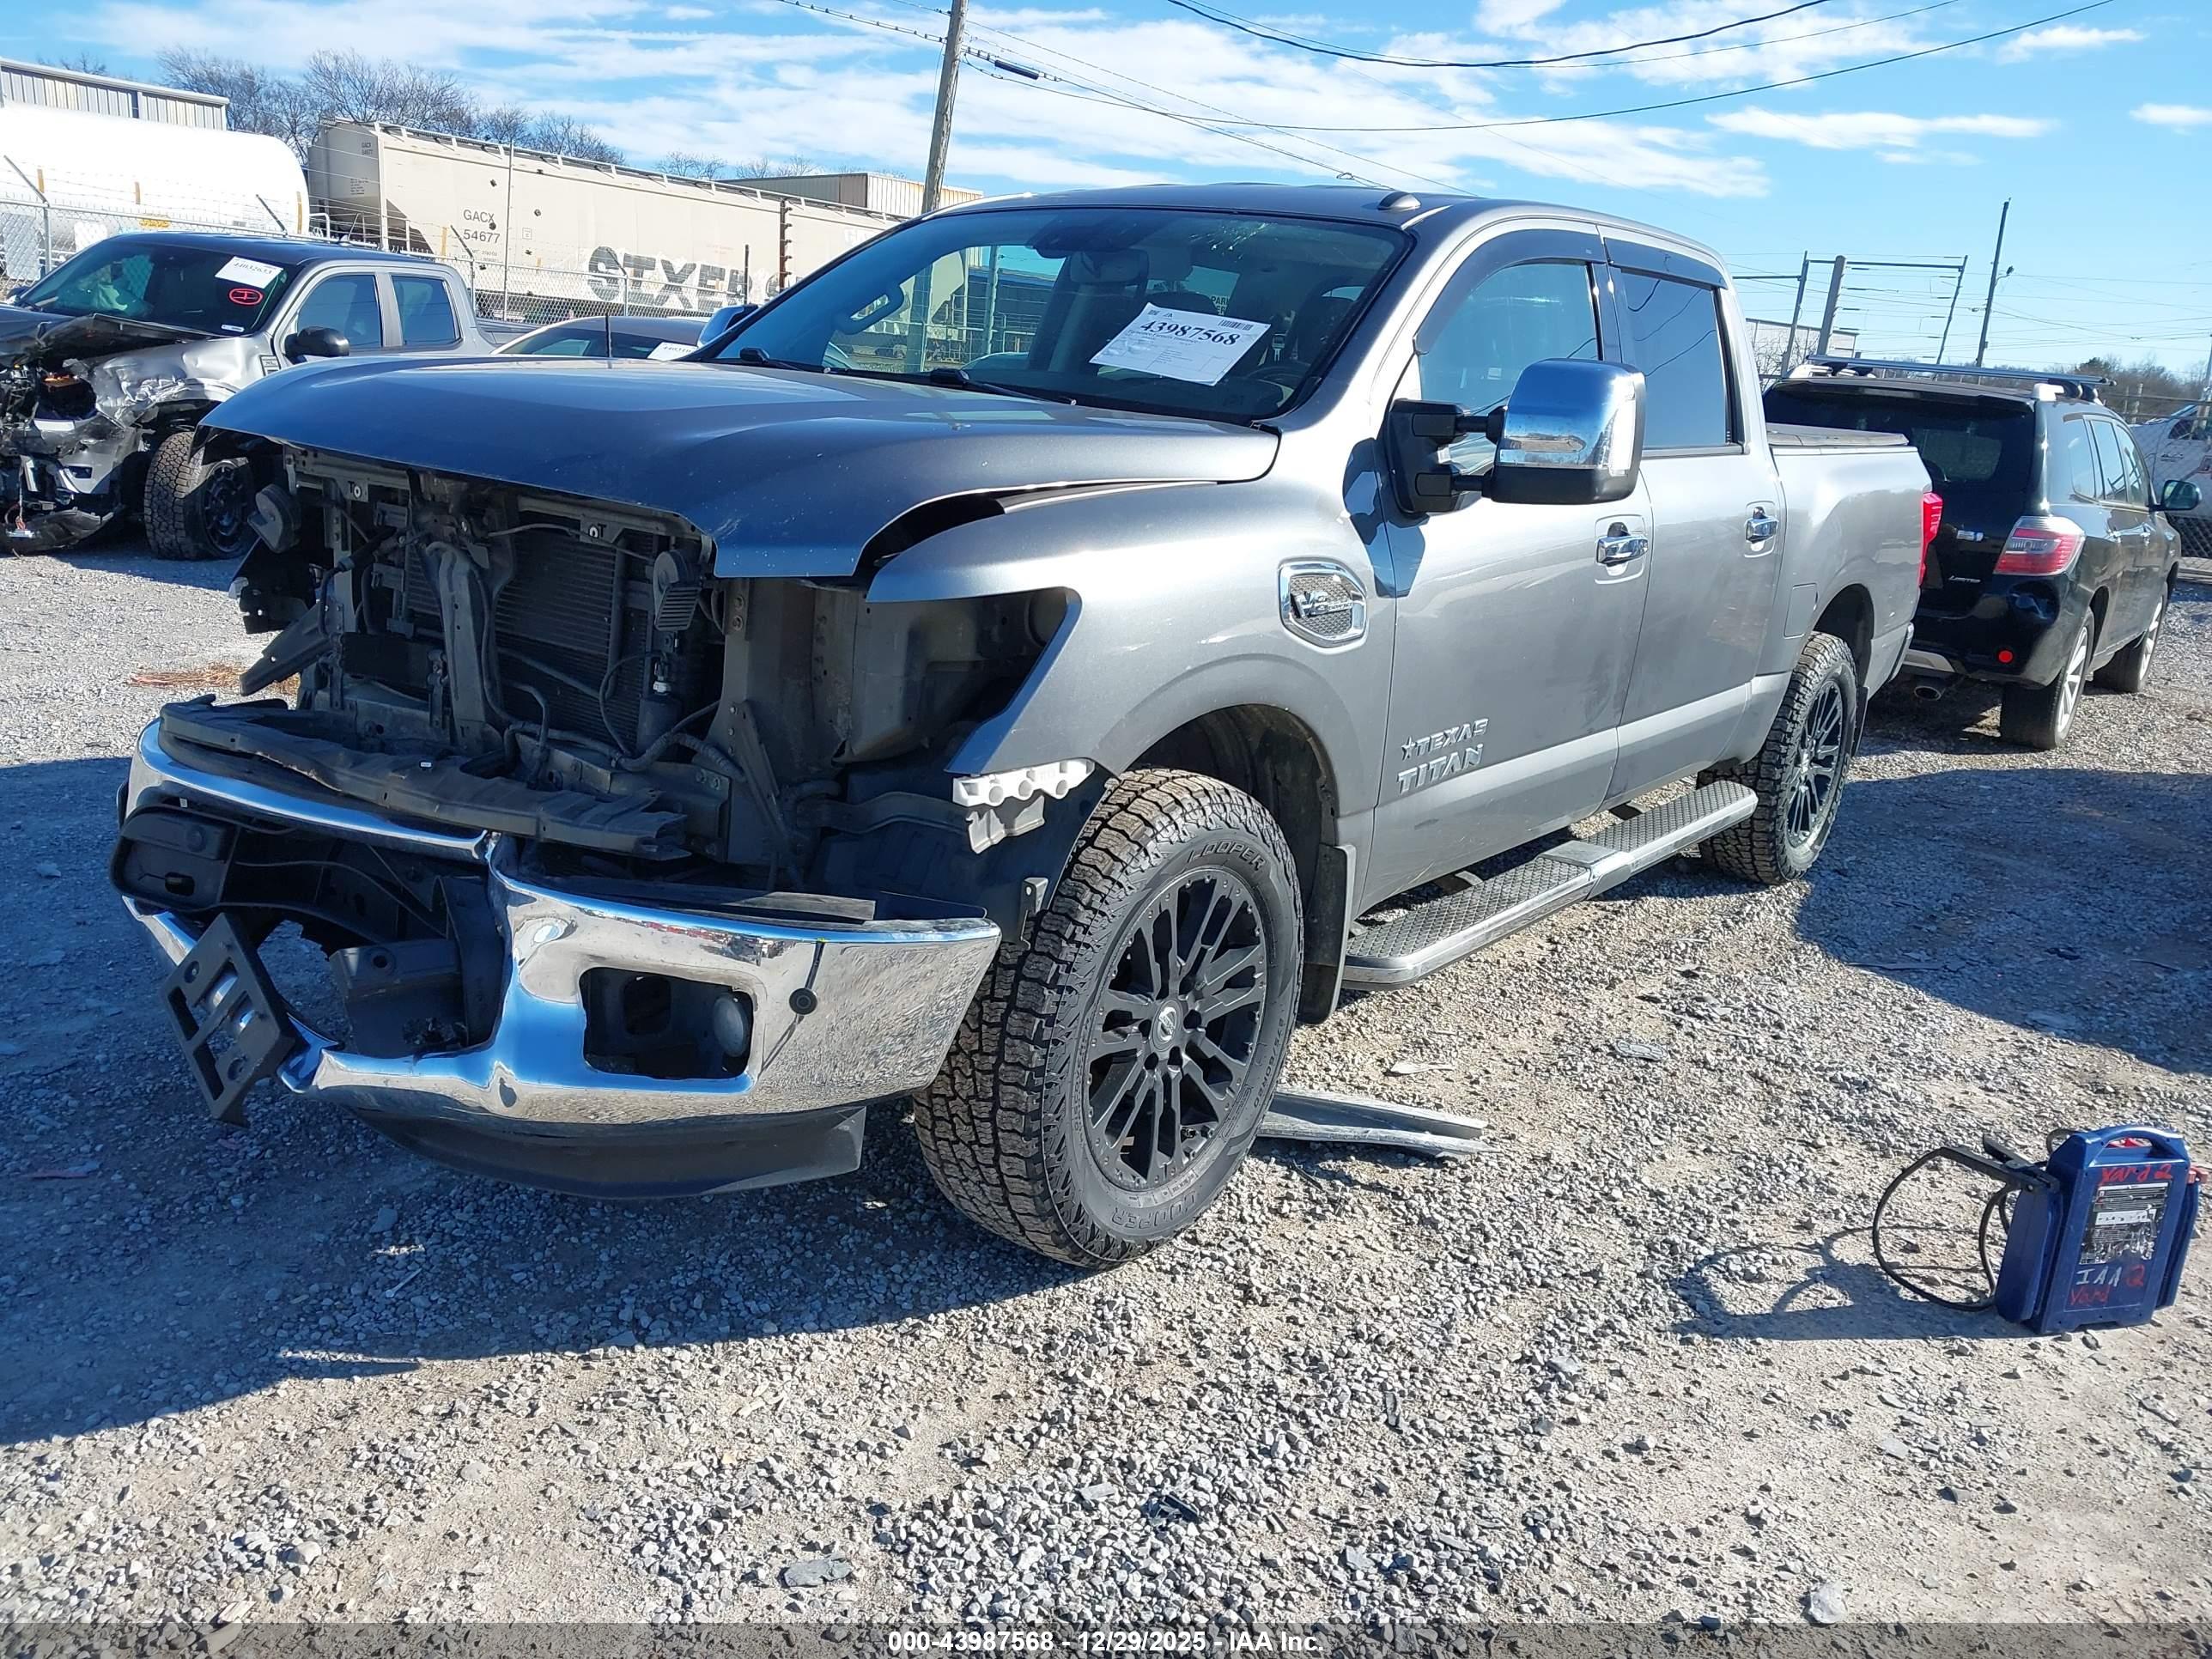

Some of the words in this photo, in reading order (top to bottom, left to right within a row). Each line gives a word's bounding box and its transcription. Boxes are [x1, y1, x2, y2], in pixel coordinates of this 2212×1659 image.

[463, 209, 495, 223] GACX
[464, 228, 501, 244] 54677
[1140, 320, 1241, 345] 43987568
[1416, 718, 1489, 756] TEXAS
[1396, 744, 1484, 795] TITAN
[1187, 841, 1267, 872] COOPER
[2154, 1163, 2172, 1180] 2
[2075, 1265, 2123, 1287] IAA
[2126, 1263, 2146, 1286] 2
